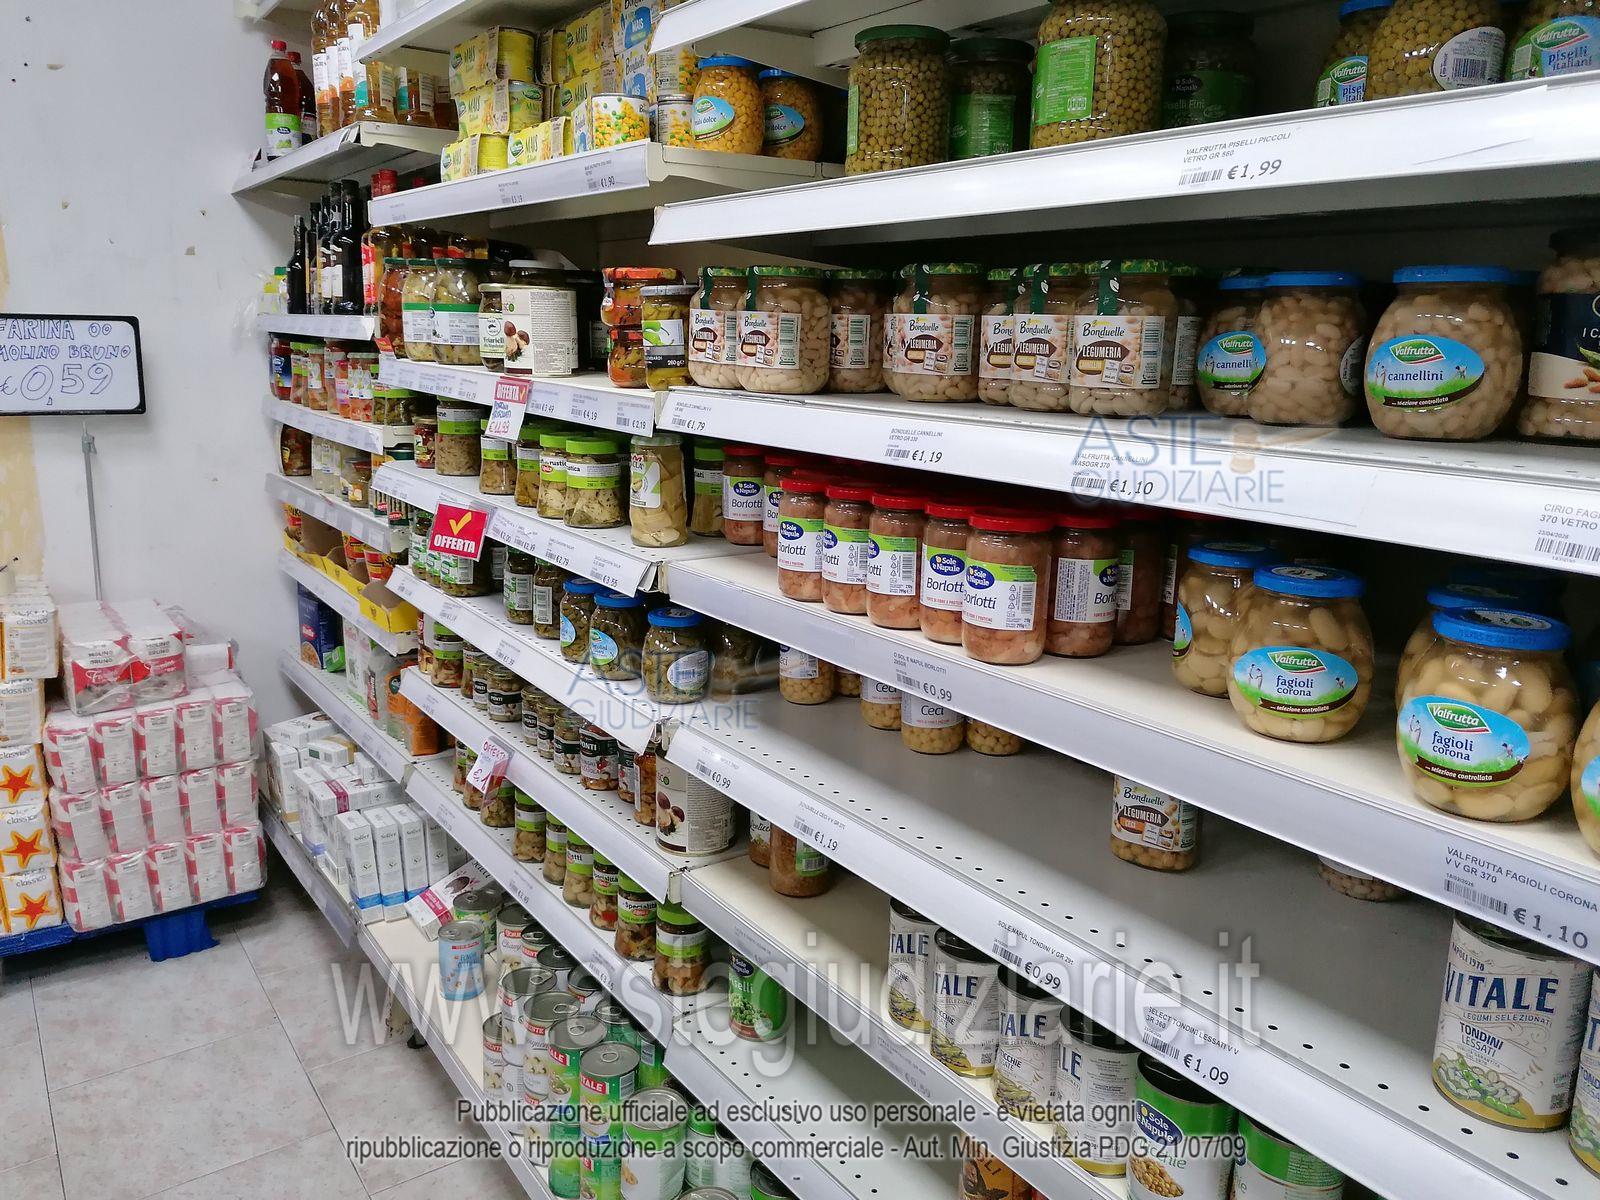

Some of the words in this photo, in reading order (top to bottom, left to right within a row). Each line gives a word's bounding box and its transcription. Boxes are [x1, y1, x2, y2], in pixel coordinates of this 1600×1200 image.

[1548, 46, 1589, 66] piselli
[1186, 142, 1227, 155] VALFRUTTA
[1228, 139, 1257, 149] PISELLI
[1258, 132, 1291, 144] PICCOLI
[1183, 153, 1208, 163] VETRO
[1209, 152, 1220, 160] GR
[1227, 159, 1282, 180] €1,99
[908, 321, 939, 333] Bonduelle
[1019, 320, 1053, 336] Bonduelle
[1082, 322, 1125, 339] Bonduelle
[69, 344, 131, 361] BRUNO
[1019, 342, 1049, 355] LEGUMERIA
[1082, 345, 1122, 359] LEGUMERIA
[1394, 344, 1436, 359] Valfrutta
[1387, 369, 1444, 383] cannellini
[911, 449, 943, 464] €1,19
[1109, 478, 1154, 496] €1,10
[731, 498, 763, 510] Borlotti
[1544, 503, 1574, 515] CIRIO
[1539, 514, 1558, 524] 370
[1561, 517, 1598, 531] VETRO
[433, 534, 476, 554] OFFERTA
[937, 562, 961, 573] Napule
[942, 557, 957, 565] Sole
[973, 568, 987, 579] Sole
[1273, 652, 1318, 667] Valfrutta
[1276, 675, 1314, 690] fagioli
[1276, 686, 1312, 698] corona
[921, 704, 945, 716] Ceci
[1432, 705, 1479, 727] Valfrutta
[1431, 731, 1474, 752] fagioli
[1432, 744, 1471, 762] corona
[711, 771, 731, 789] €0,99
[1430, 765, 1457, 779] selezione
[1457, 772, 1493, 782] controllata
[1123, 786, 1165, 807] Bonduelle
[1123, 804, 1162, 825] LEGUMERIA
[813, 831, 838, 851] €1,19
[1445, 857, 1452, 865] V
[1463, 864, 1478, 876] GR
[1480, 871, 1497, 884] 370
[1447, 846, 1503, 875] VALFRUTTA
[1505, 869, 1548, 892] FAGIOLI
[1549, 887, 1599, 913] CORONA
[1012, 929, 1029, 945] NAPUL
[1029, 937, 1051, 955] TONDINI
[1056, 951, 1065, 961] GR
[1469, 957, 1486, 972] 1978
[1024, 961, 1062, 990] €0,99
[1444, 961, 1560, 1014] VITALE
[1145, 1014, 1156, 1024] GR
[1156, 1018, 1167, 1030] 360
[1149, 1005, 1172, 1025] SELECT
[1172, 1018, 1199, 1038] TONDINI
[1199, 1031, 1228, 1051] LESSATI
[1462, 1012, 1493, 1023] LEGUMI
[1495, 1014, 1553, 1028] SELEZIONATI
[1459, 1021, 1504, 1051] TONDINI
[1461, 1034, 1498, 1059] LESSATI
[1183, 1053, 1230, 1086] €1,09
[1148, 1112, 1170, 1131] Sole
